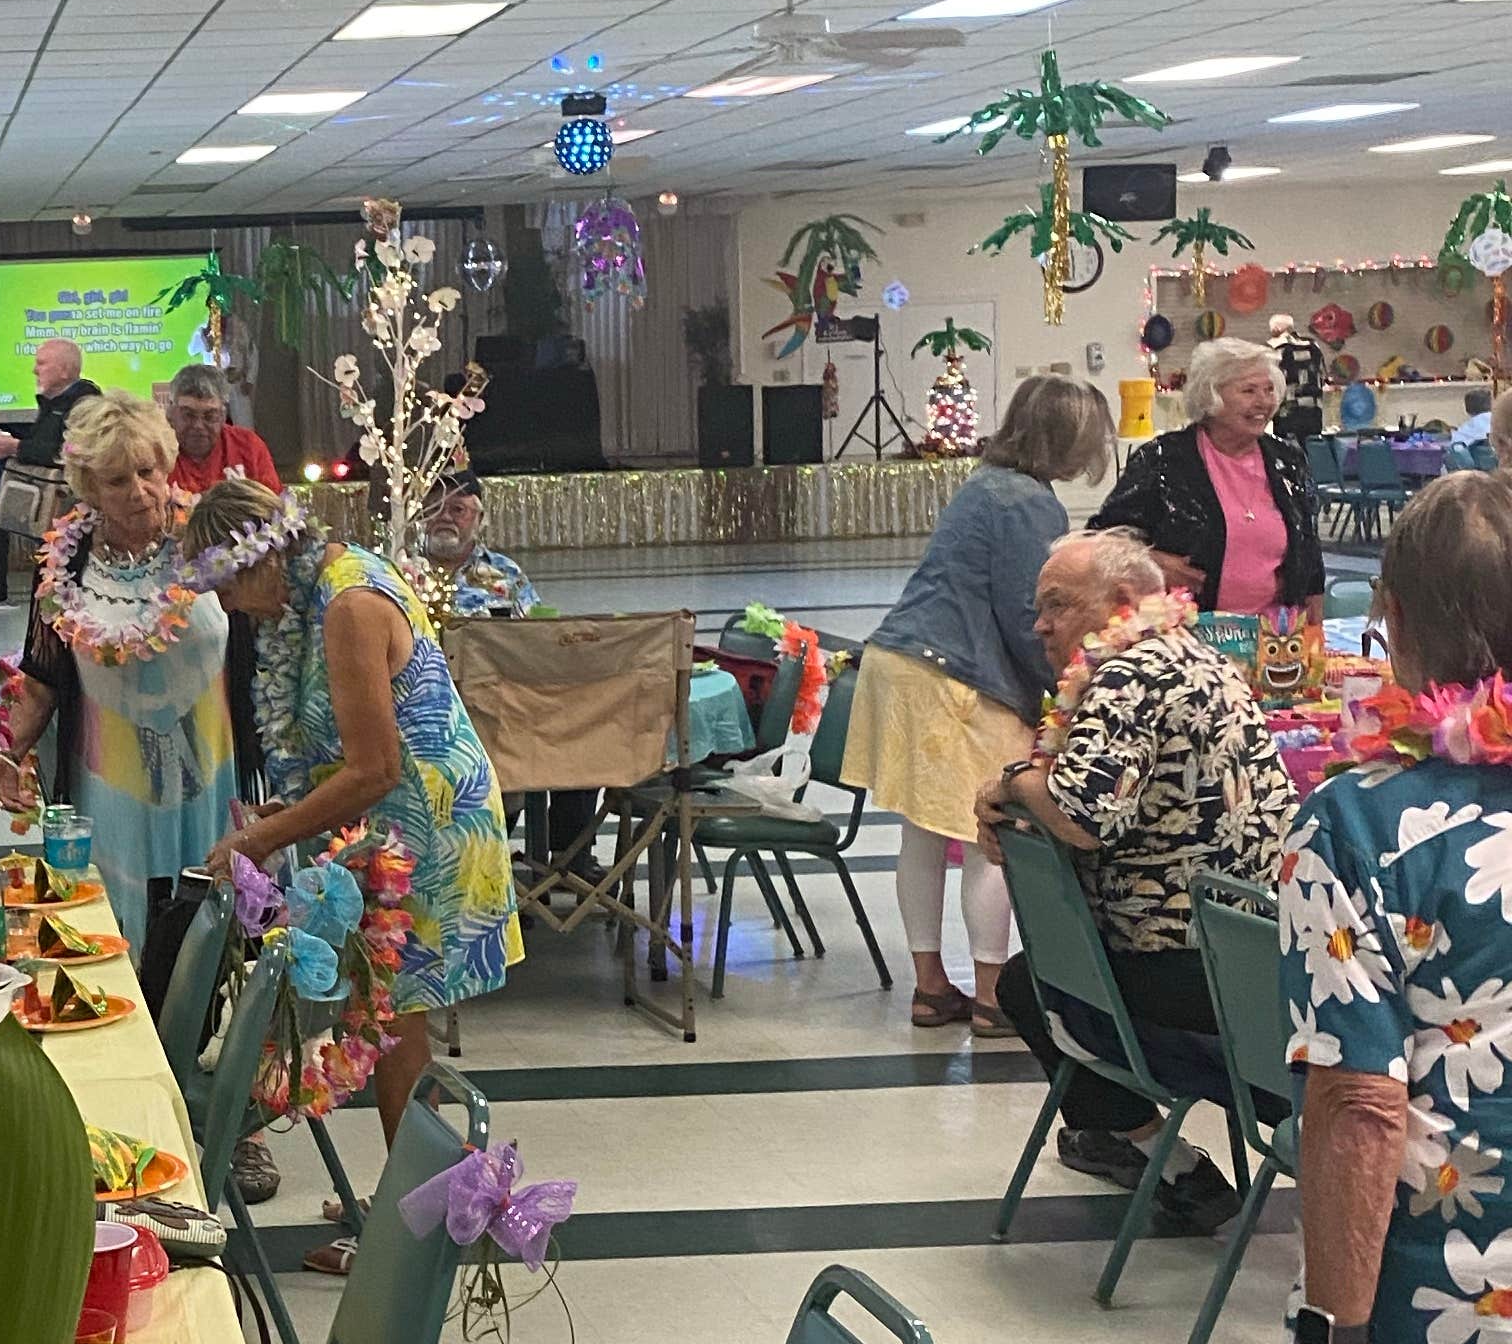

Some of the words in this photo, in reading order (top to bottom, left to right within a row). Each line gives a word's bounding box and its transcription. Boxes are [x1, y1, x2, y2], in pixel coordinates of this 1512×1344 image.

[85, 307, 103, 320] set
[105, 309, 123, 319] me
[125, 308, 139, 318] on
[143, 306, 162, 318] fire
[62, 327, 77, 339] my
[80, 324, 109, 336] brain
[112, 323, 122, 335] is
[85, 340, 117, 353] which
[119, 342, 142, 354] way
[144, 340, 156, 351] to
[158, 341, 173, 353] go
